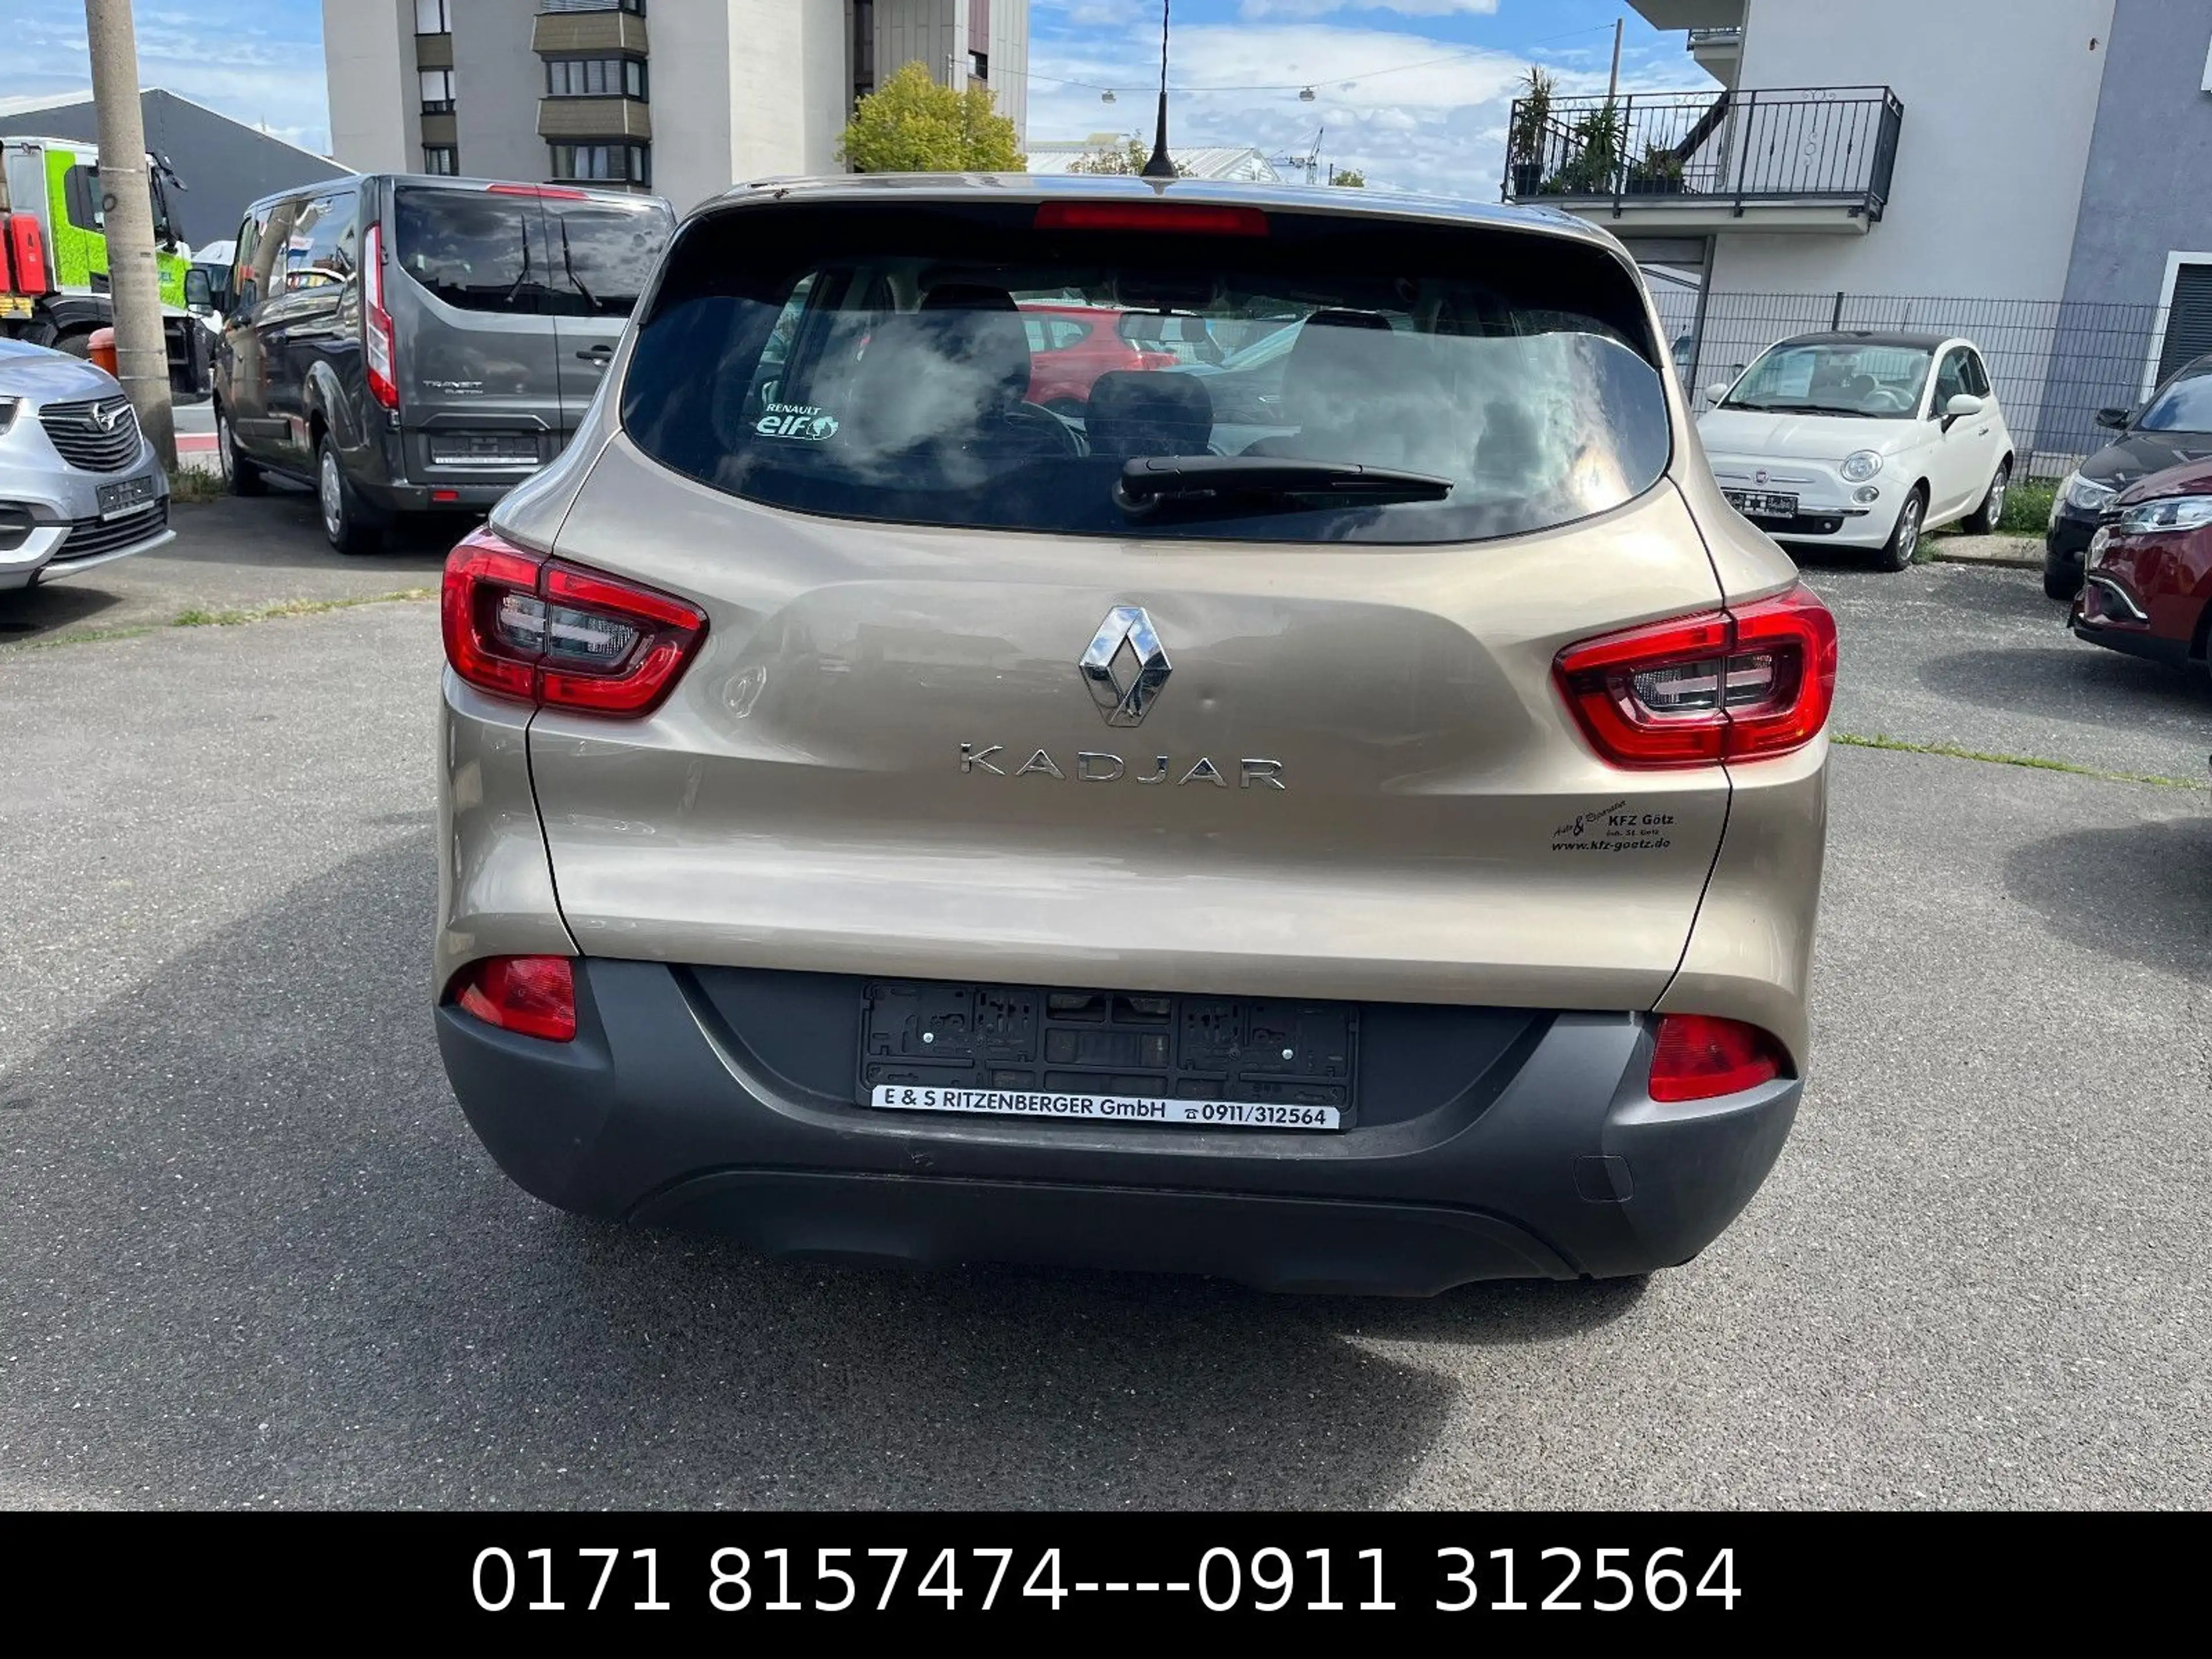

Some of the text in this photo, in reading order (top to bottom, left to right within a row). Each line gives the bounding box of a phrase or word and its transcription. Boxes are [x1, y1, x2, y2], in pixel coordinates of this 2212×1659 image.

[766, 403, 822, 415] RENAULT
[756, 415, 811, 435] elf
[960, 743, 1285, 789] KADJAR
[1573, 816, 1584, 836] &
[1608, 814, 1674, 826] KFZ Götz
[1552, 838, 1671, 852] www.kfz-goetz.de
[885, 1088, 1326, 1125] E & S RITZENBERGER GmbH 0911/312564
